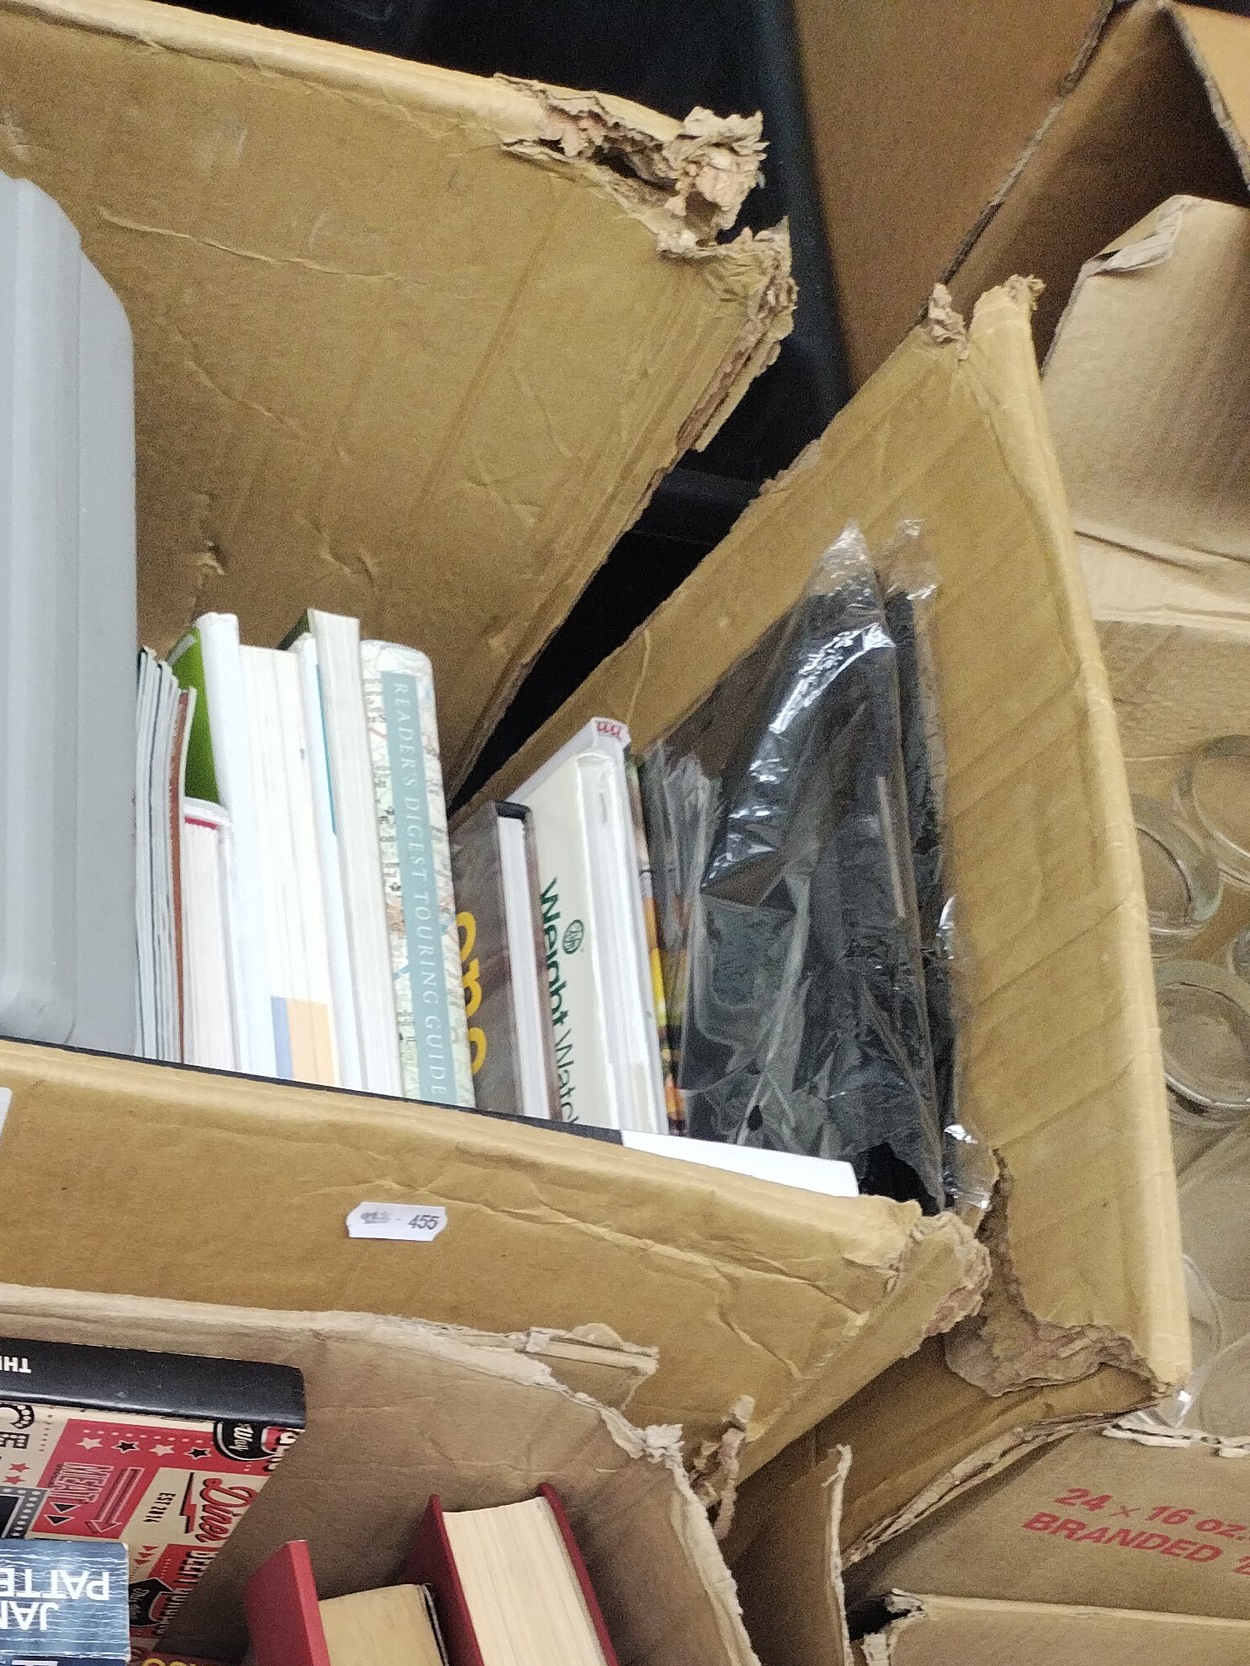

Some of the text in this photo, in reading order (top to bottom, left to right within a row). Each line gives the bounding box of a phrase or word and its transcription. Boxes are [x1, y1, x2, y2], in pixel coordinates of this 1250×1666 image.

[392, 681, 448, 1096] READER'S DIGEST TOURING GUIDE
[407, 1214, 441, 1231] 455
[50, 1460, 116, 1505] MEAT
[1053, 1487, 1114, 1512] 24
[1145, 1505, 1197, 1526] 16
[1021, 1511, 1224, 1563] BRANDED
